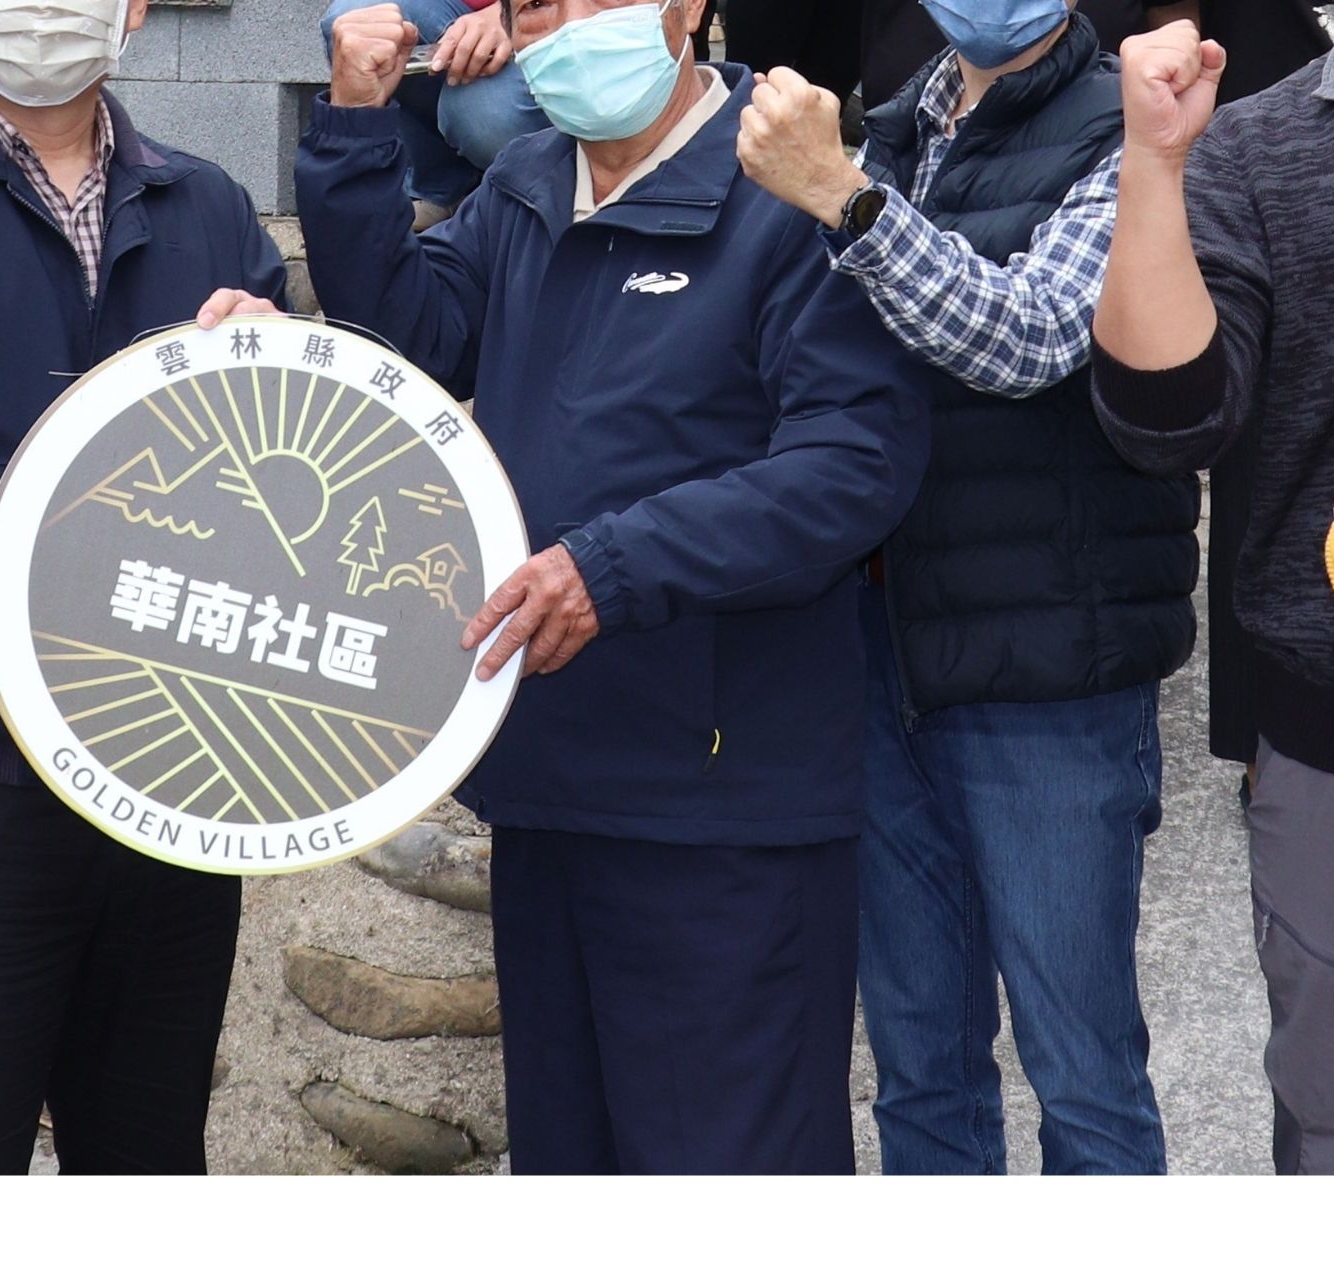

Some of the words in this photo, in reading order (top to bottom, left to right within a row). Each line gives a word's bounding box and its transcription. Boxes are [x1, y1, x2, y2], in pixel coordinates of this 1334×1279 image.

[155, 328, 464, 446] 雲林縣政府
[109, 558, 388, 690] 華南社區
[52, 746, 182, 847] GOLDEN
[199, 819, 355, 860] VILLAGE
